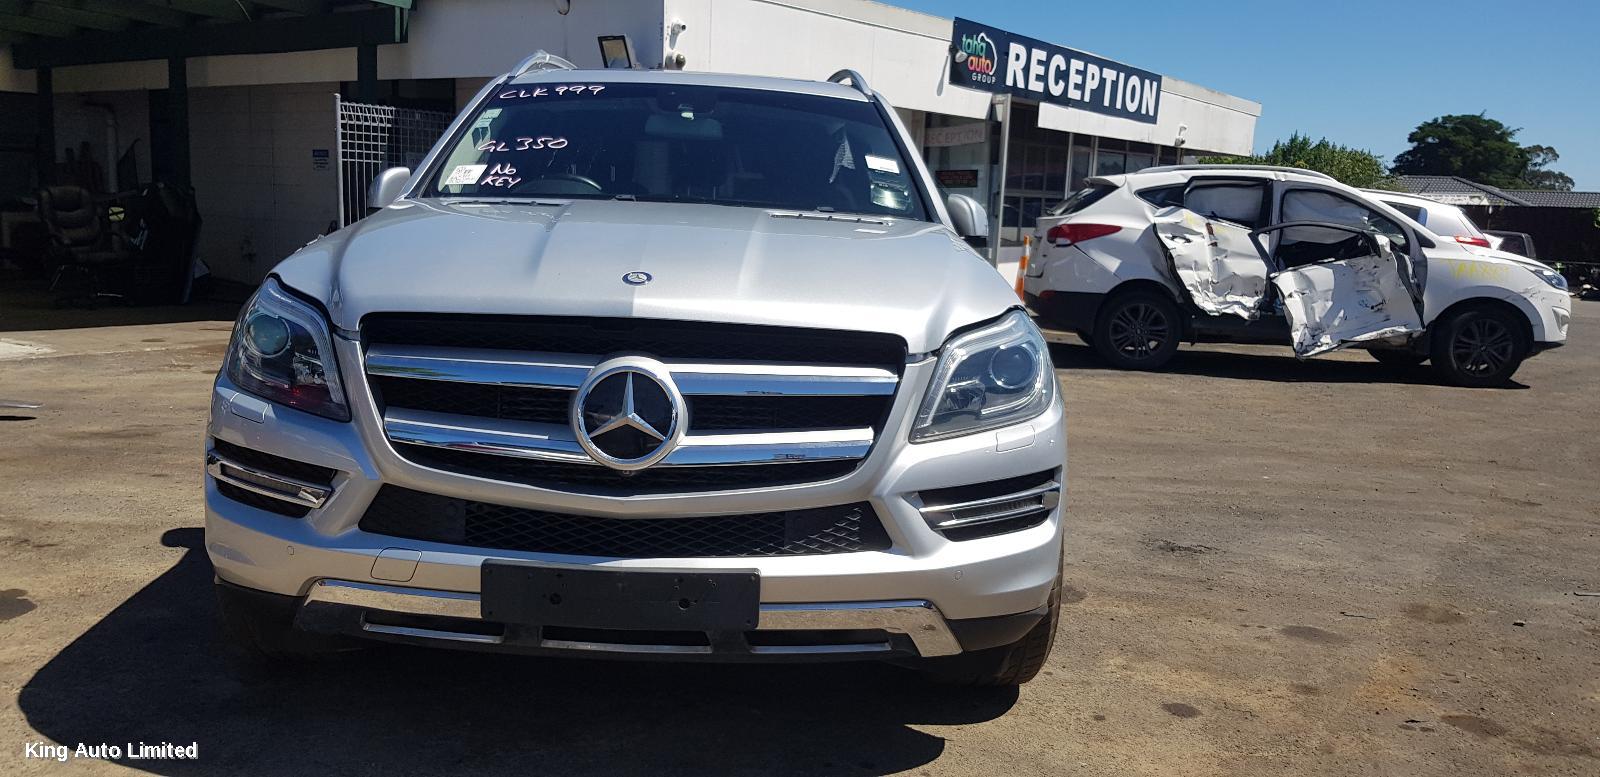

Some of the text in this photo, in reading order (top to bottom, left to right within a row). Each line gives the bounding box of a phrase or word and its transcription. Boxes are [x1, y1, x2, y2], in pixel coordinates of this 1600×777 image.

[968, 55, 992, 74] auto
[972, 73, 996, 85] GROUP
[1005, 42, 1158, 117] RECEPTION
[499, 84, 606, 99] CLK 999
[477, 137, 568, 153] GL 350
[481, 175, 522, 188] KEY
